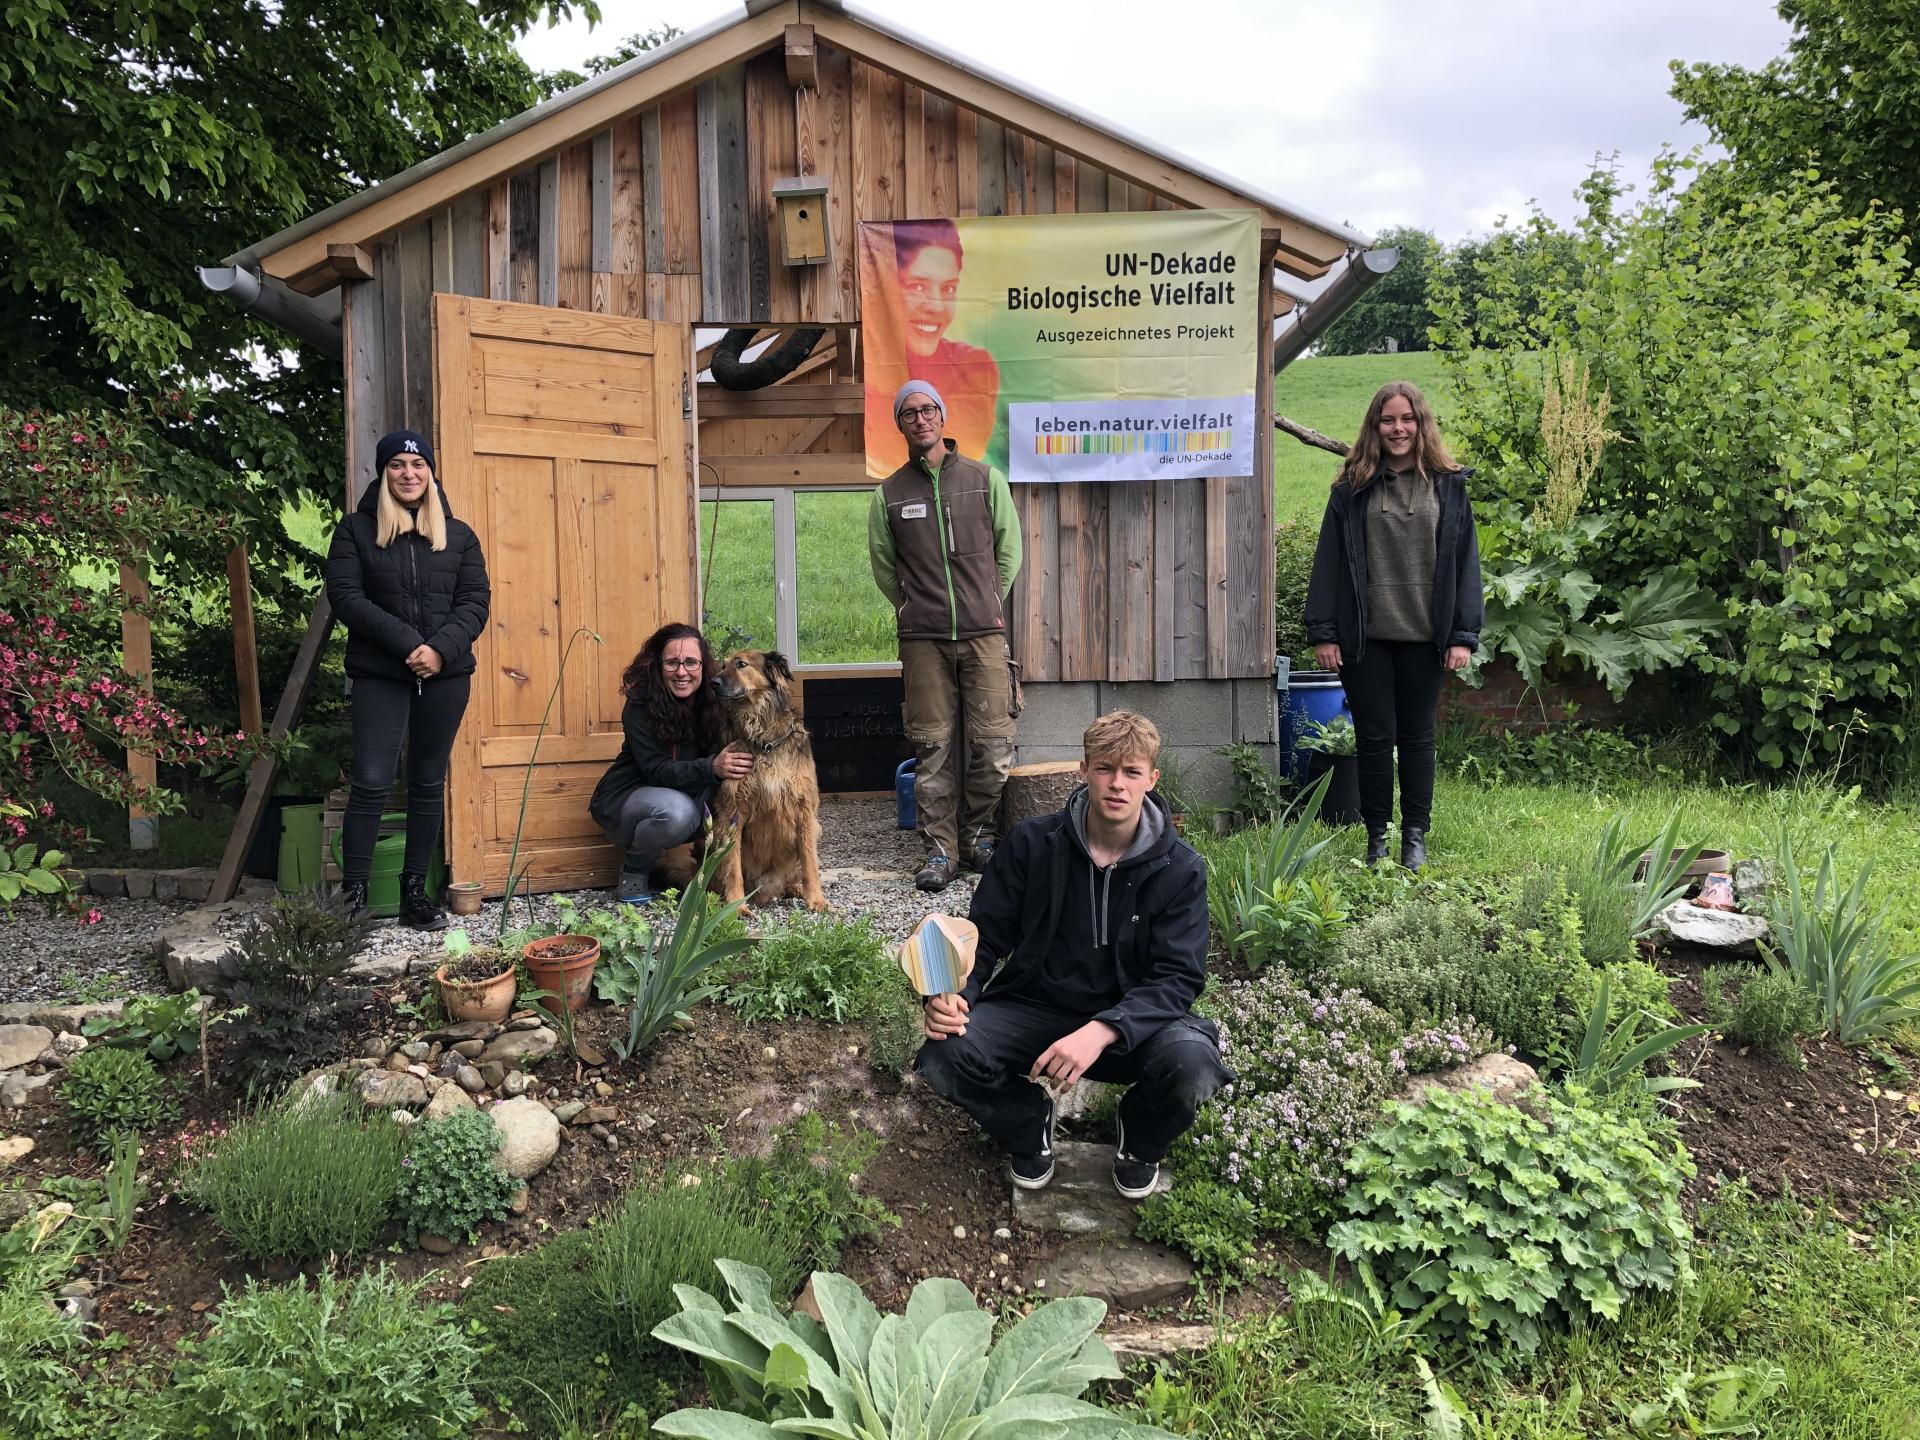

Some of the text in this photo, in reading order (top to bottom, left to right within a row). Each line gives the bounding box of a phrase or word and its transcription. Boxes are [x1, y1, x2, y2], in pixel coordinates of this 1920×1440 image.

[1105, 251, 1236, 277] UN-Dekade
[1007, 281, 1235, 314] Biologische Vielfalt
[1036, 324, 1235, 345] Ausgezeichnetes Projekt
[1035, 413, 1233, 433] leben.natur.vielfalt
[404, 439, 419, 453] NY
[1159, 452, 1232, 464] die UN-Dekade
